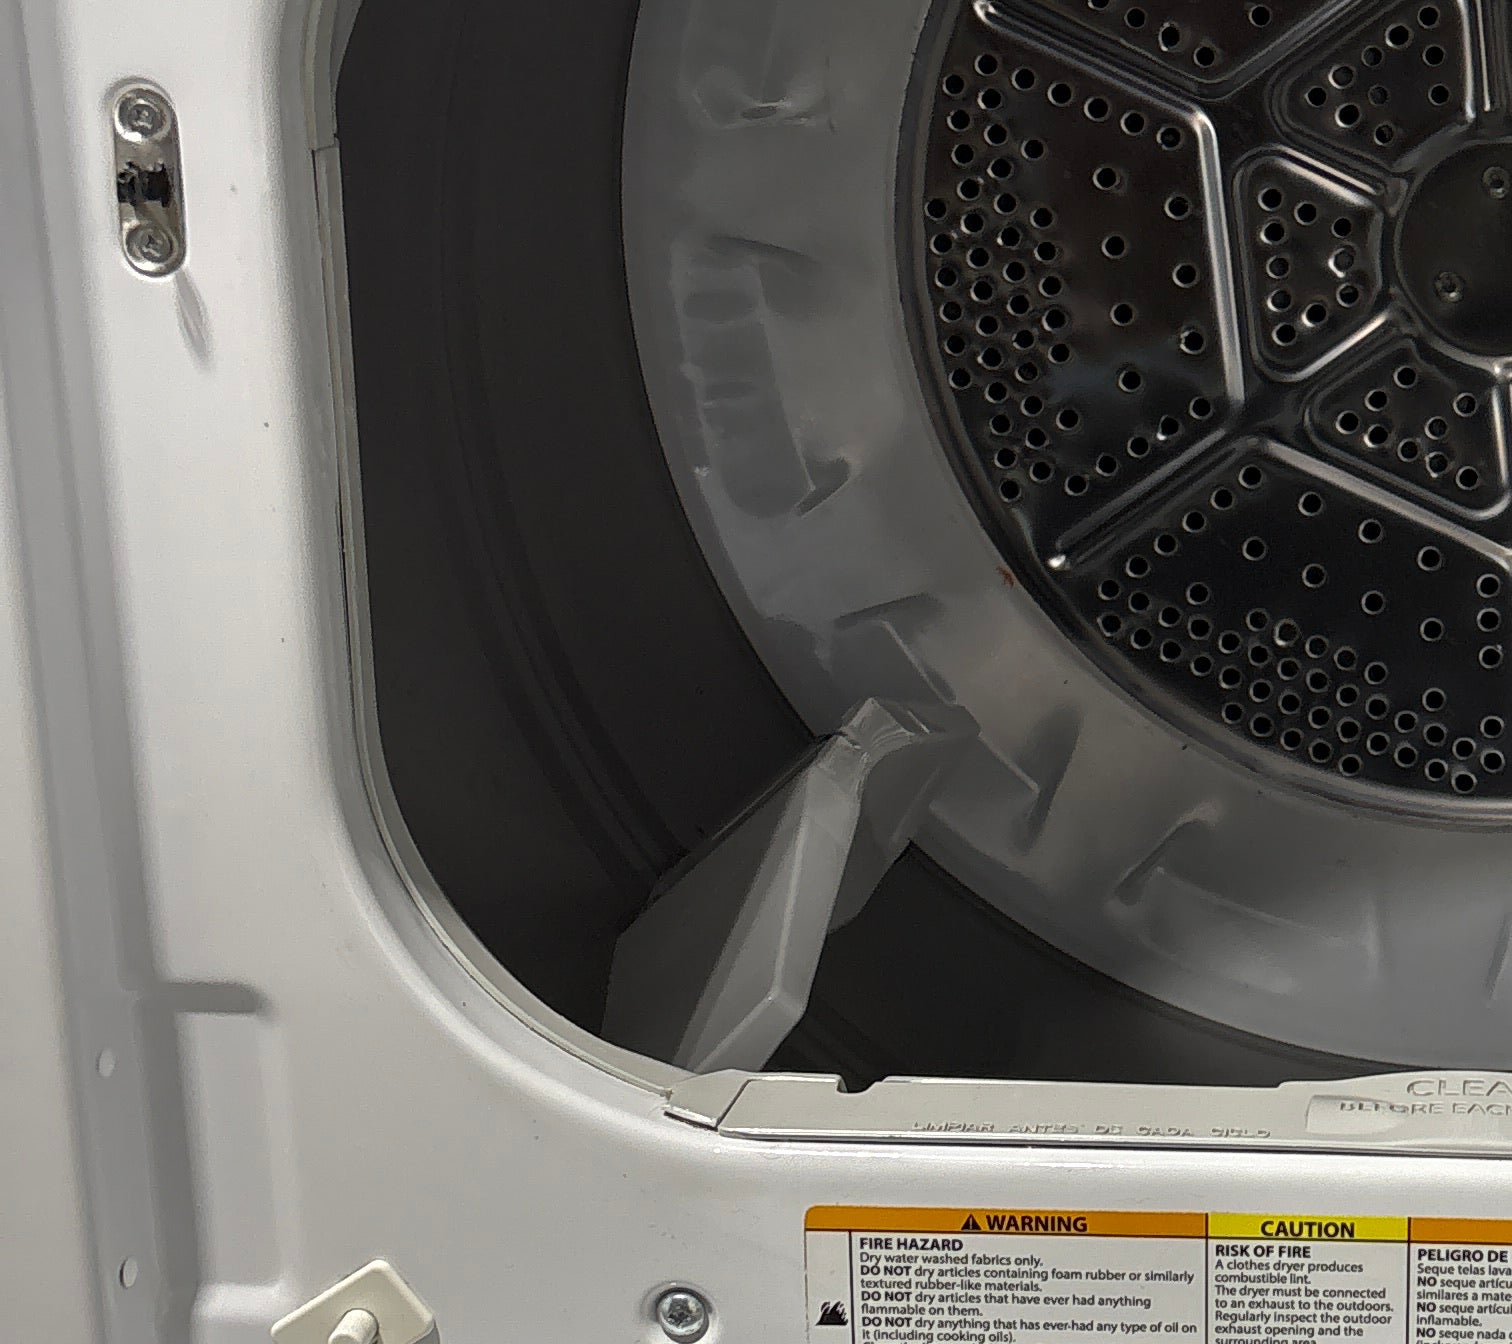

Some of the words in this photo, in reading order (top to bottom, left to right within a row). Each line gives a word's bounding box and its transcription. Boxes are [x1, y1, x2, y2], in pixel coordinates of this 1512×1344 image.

[1340, 1102, 1443, 1115] BEFORE
[986, 1215, 1088, 1232] WARNING
[1260, 1221, 1356, 1238] CAUTION
[859, 1238, 892, 1250] FIRE
[896, 1238, 964, 1251] HAZARD
[1215, 1245, 1249, 1257] RISK
[1253, 1245, 1273, 1257] OF
[1277, 1246, 1312, 1258] FIRE
[860, 1252, 881, 1266] Dry
[884, 1253, 918, 1263] water
[921, 1253, 968, 1264] washed
[971, 1254, 1011, 1265] fabrics
[1014, 1255, 1044, 1269] only.
[1418, 1249, 1483, 1262] PELIGRO
[1487, 1251, 1507, 1263] DE
[1215, 1259, 1223, 1270] A
[1226, 1259, 1270, 1271] clothes
[1272, 1260, 1304, 1274] dryer
[1307, 1261, 1364, 1275] produces
[1418, 1264, 1454, 1278] Seque
[1457, 1265, 1485, 1275] telas
[860, 1265, 880, 1276] DO
[883, 1266, 911, 1276] NOT
[914, 1266, 934, 1280] dry
[937, 1266, 980, 1278] articles
[983, 1268, 1048, 1282] containing
[1051, 1269, 1082, 1279] foam
[1085, 1269, 1125, 1280] rubber
[1128, 1272, 1140, 1280] or
[1144, 1270, 1194, 1284] similarly
[1214, 1272, 1287, 1284] combustible
[1289, 1273, 1312, 1284] lint.
[860, 1278, 912, 1289] textured
[914, 1279, 981, 1291] rubber-like
[984, 1280, 1042, 1292] materials.
[1416, 1276, 1437, 1287] NO
[1440, 1278, 1475, 1291] seque
[1216, 1285, 1236, 1295] The
[1238, 1285, 1269, 1299] dryer
[1272, 1287, 1301, 1297] must
[1304, 1287, 1319, 1297] be
[1322, 1287, 1386, 1298] connected
[861, 1303, 925, 1315] flammable
[928, 1307, 944, 1315] on
[947, 1305, 984, 1316] them.
[1216, 1298, 1227, 1308] to
[1230, 1300, 1245, 1308] an
[1247, 1298, 1294, 1309] exhaust
[1298, 1300, 1310, 1310] to
[1313, 1300, 1333, 1310] the
[1336, 1300, 1394, 1311] outdoors.
